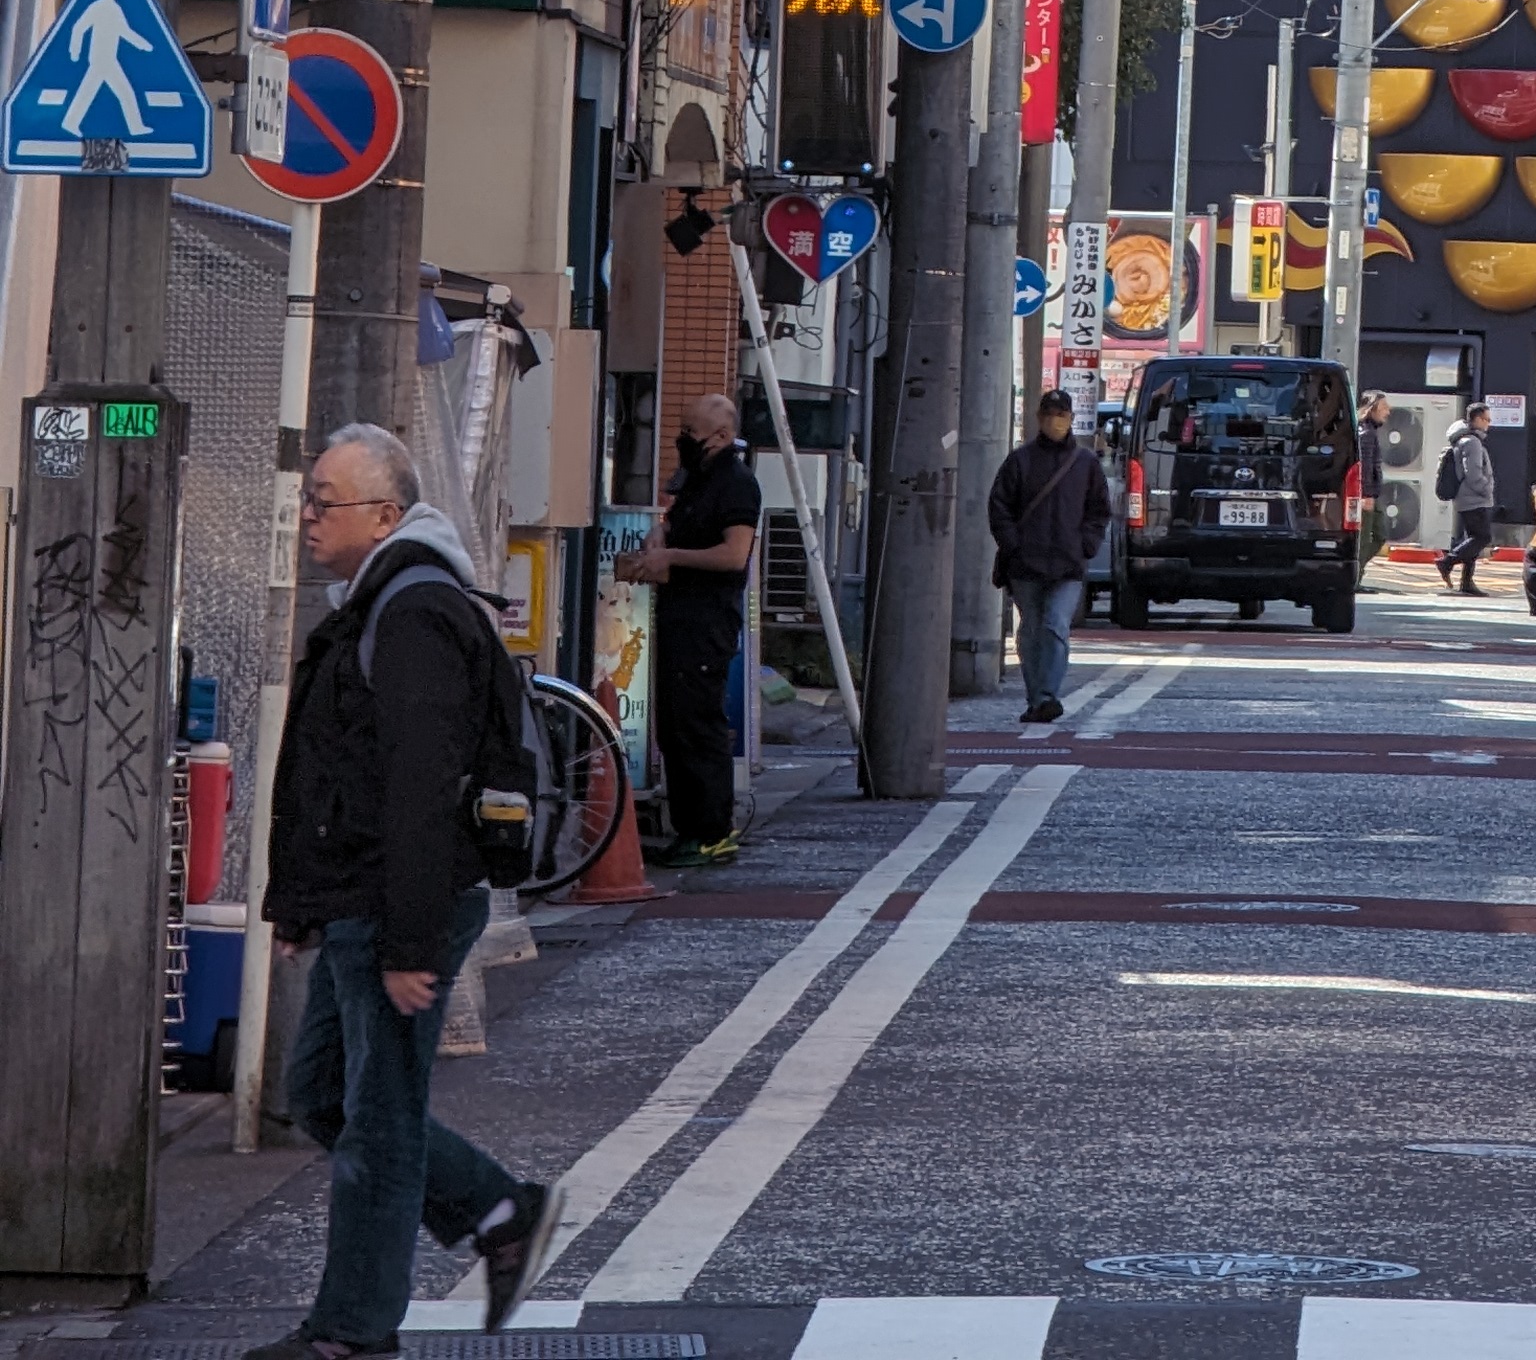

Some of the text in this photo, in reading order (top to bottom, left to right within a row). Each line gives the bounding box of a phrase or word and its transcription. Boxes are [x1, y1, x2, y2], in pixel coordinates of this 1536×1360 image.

[788, 230, 814, 256] 満
[827, 230, 853, 256] 空
[1070, 274, 1097, 346] みかさ
